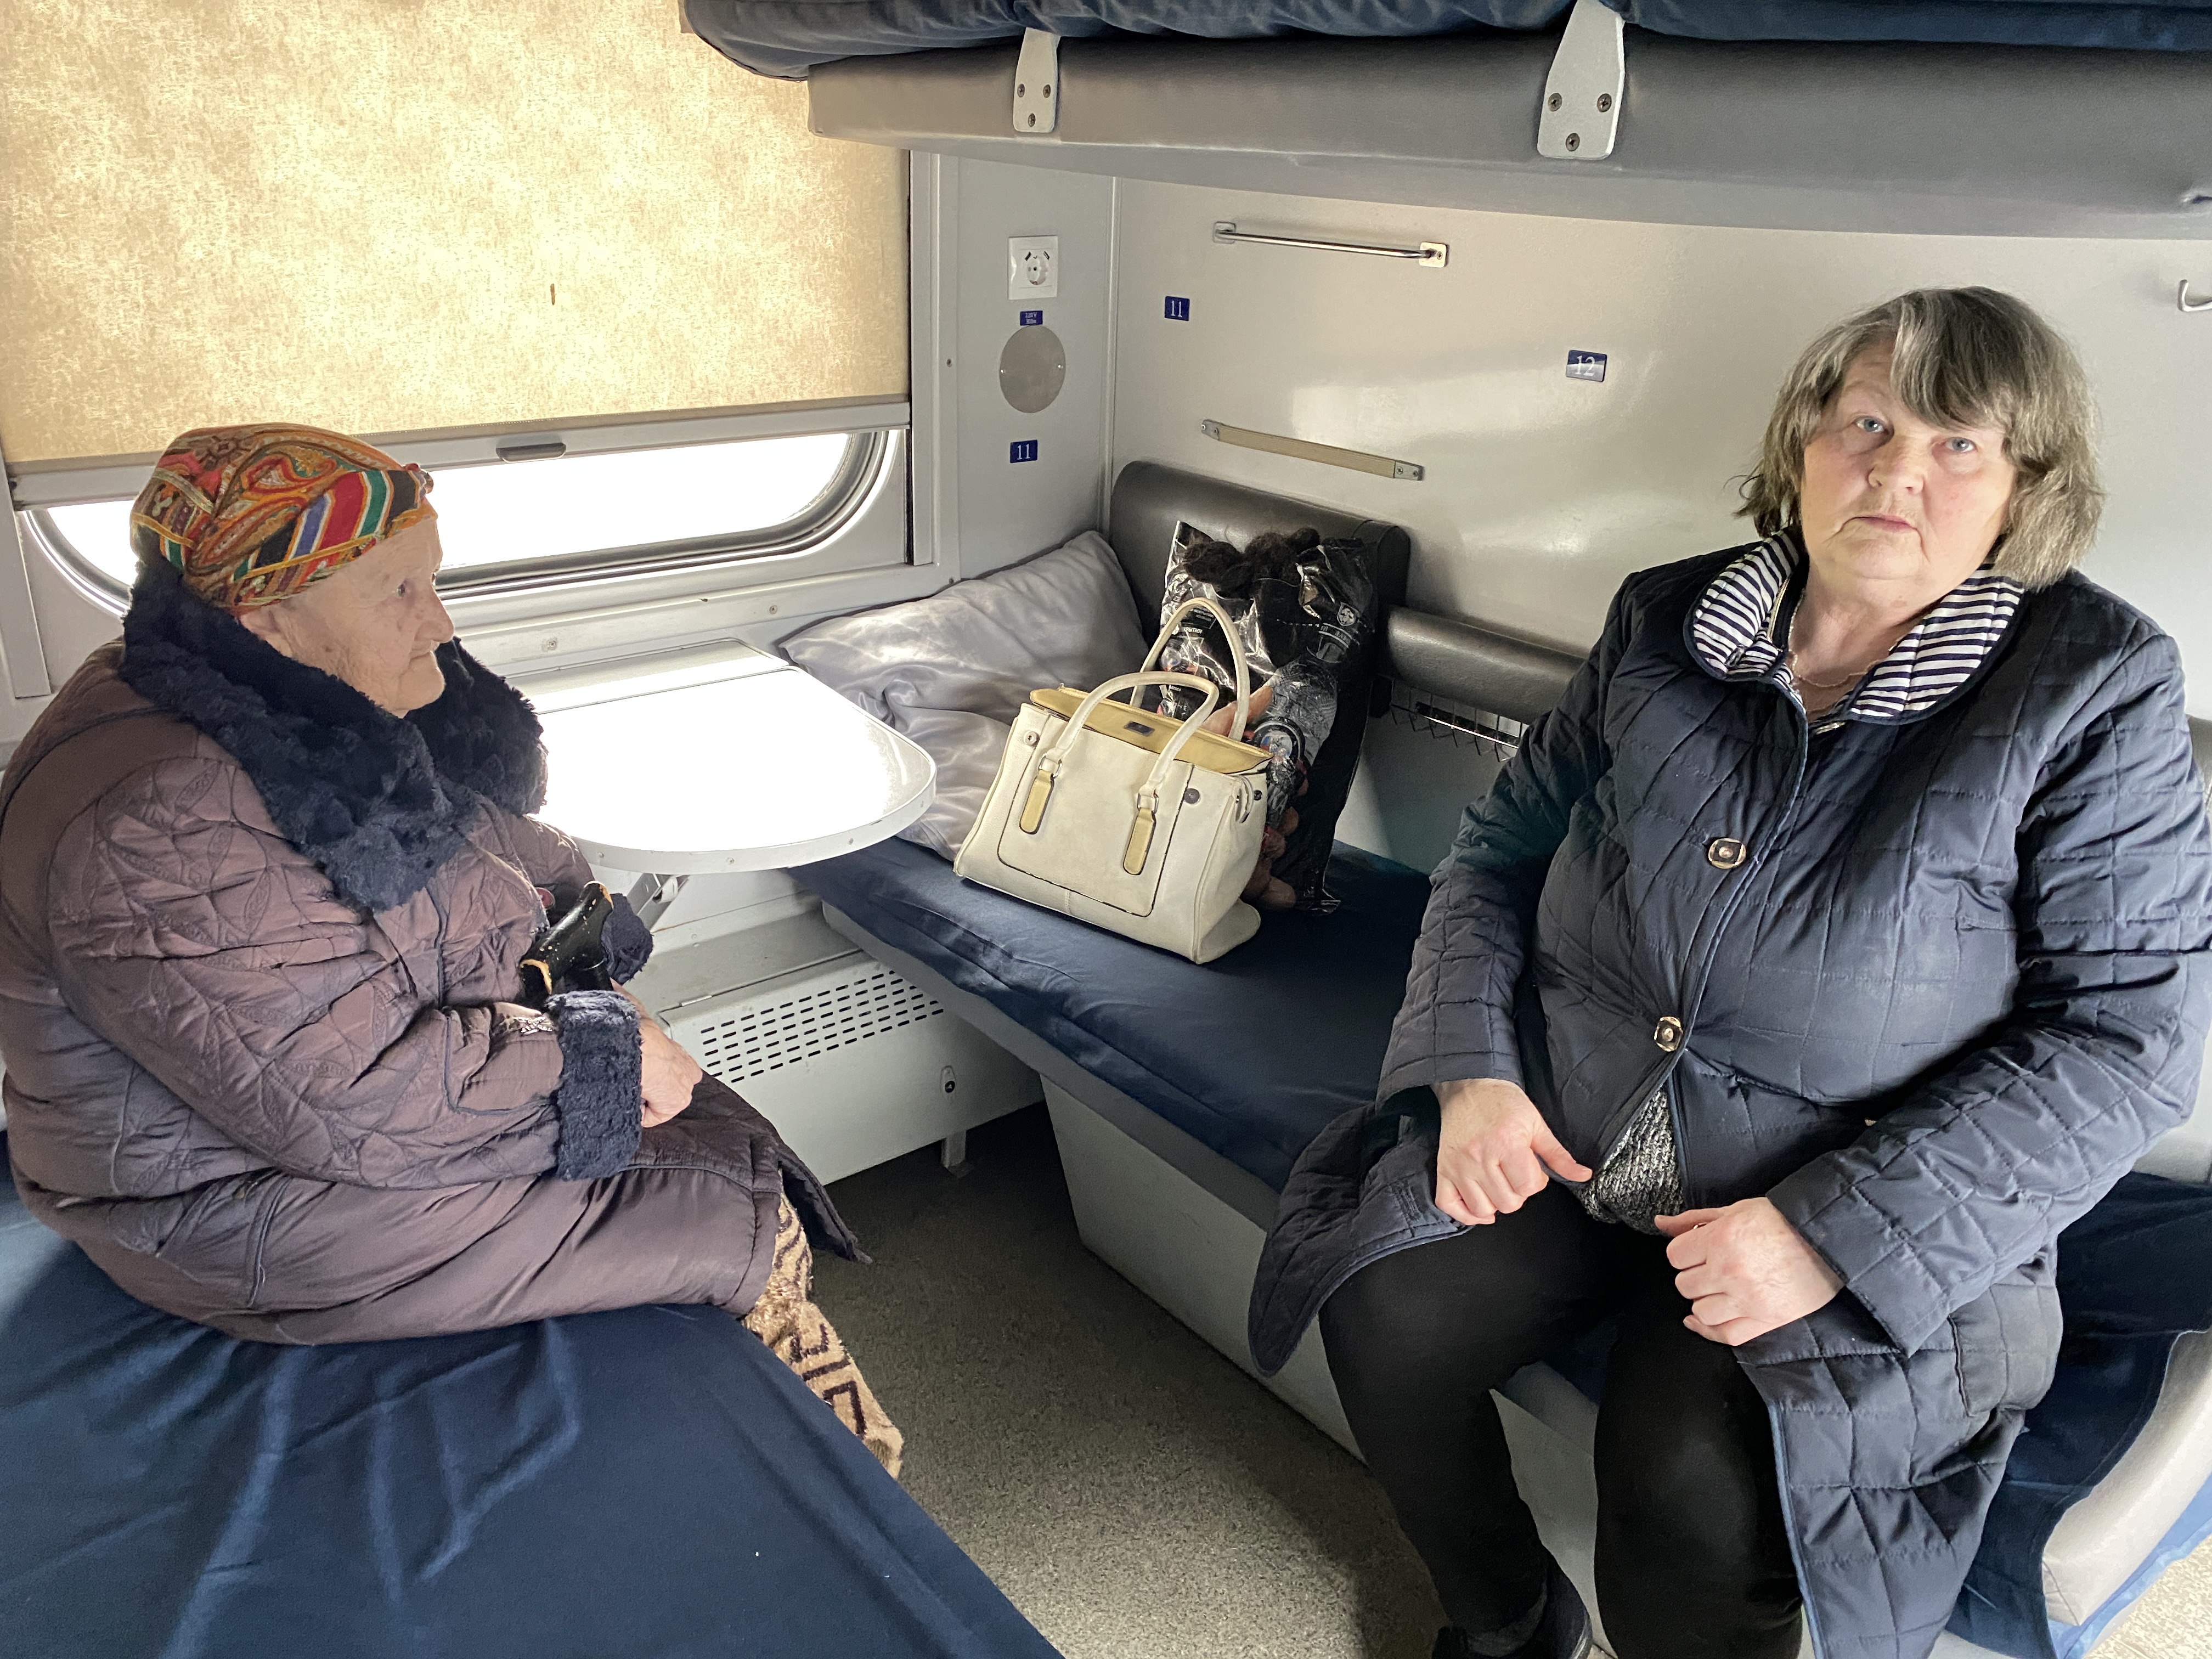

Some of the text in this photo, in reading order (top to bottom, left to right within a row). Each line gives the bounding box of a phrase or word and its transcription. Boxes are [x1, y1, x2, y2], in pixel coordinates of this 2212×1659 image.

[1171, 300, 1182, 318] 11
[1575, 355, 1595, 377] 12
[1017, 443, 1031, 460] 11
